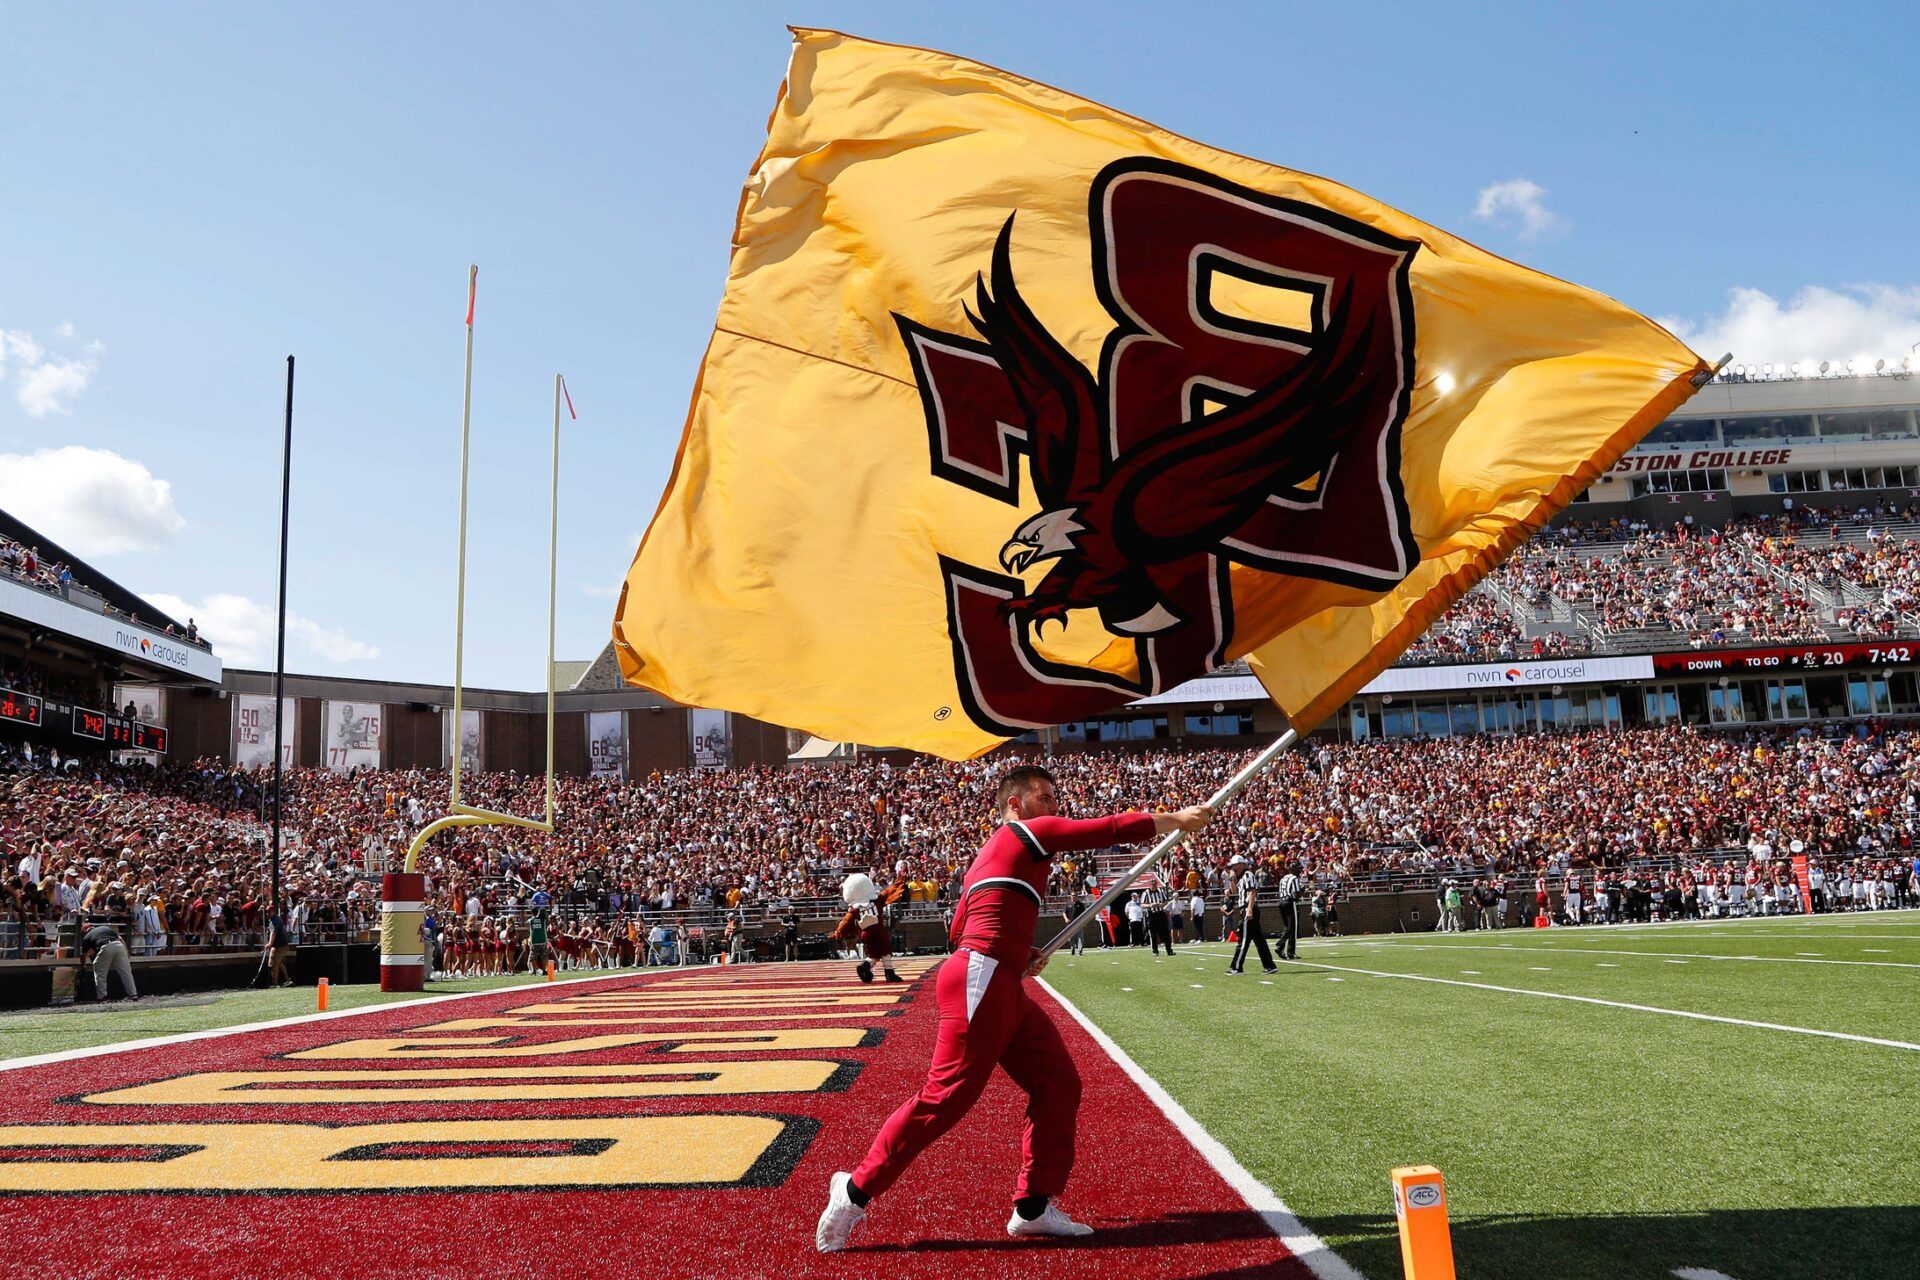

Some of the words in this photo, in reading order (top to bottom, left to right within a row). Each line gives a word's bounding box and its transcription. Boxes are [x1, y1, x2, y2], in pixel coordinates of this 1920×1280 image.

[1608, 455, 1682, 472] STON
[1689, 449, 1792, 468] COLLEGE
[116, 630, 139, 650] nwn
[152, 644, 189, 667] carousel
[1868, 647, 1912, 664] 7:42
[1688, 660, 1722, 670] DOWN
[1746, 658, 1761, 667] TO
[1763, 656, 1780, 666] GO
[1823, 652, 1844, 666] 20
[1467, 670, 1501, 684] nwn
[1525, 661, 1586, 680] carousel
[1, 701, 14, 717] 20
[29, 707, 36, 721] 2
[241, 708, 258, 727] 90
[362, 716, 379, 735] 75
[695, 735, 712, 752] 94
[329, 748, 348, 766] 77
[1414, 1190, 1434, 1199] ACC
